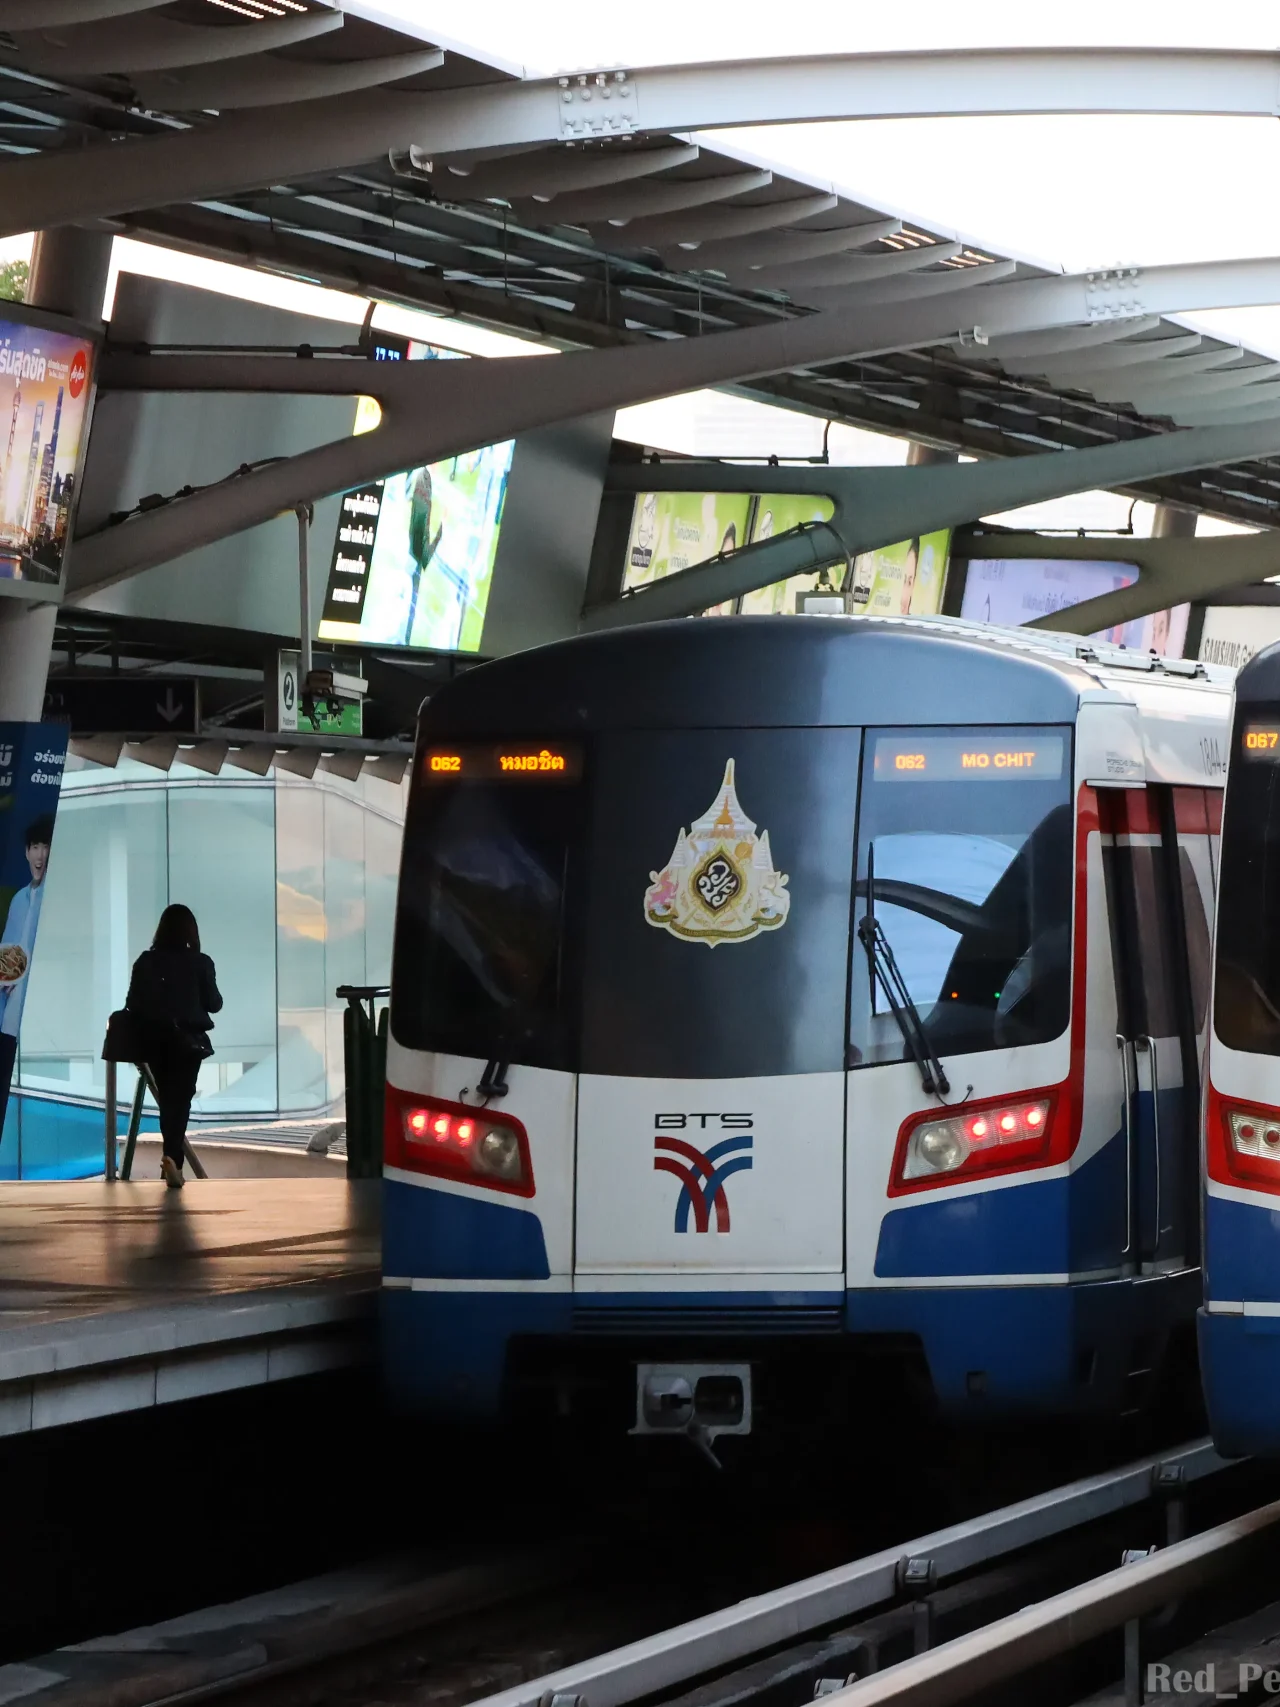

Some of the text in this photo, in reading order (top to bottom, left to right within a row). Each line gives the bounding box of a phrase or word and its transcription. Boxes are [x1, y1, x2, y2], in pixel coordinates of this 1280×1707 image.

[1203, 637, 1241, 668] SAMSUNG
[1246, 732, 1279, 749] 067
[430, 749, 565, 771] 062 หมอชิต
[895, 752, 1037, 770] 062 MO CHIT
[654, 1113, 753, 1130] BTS
